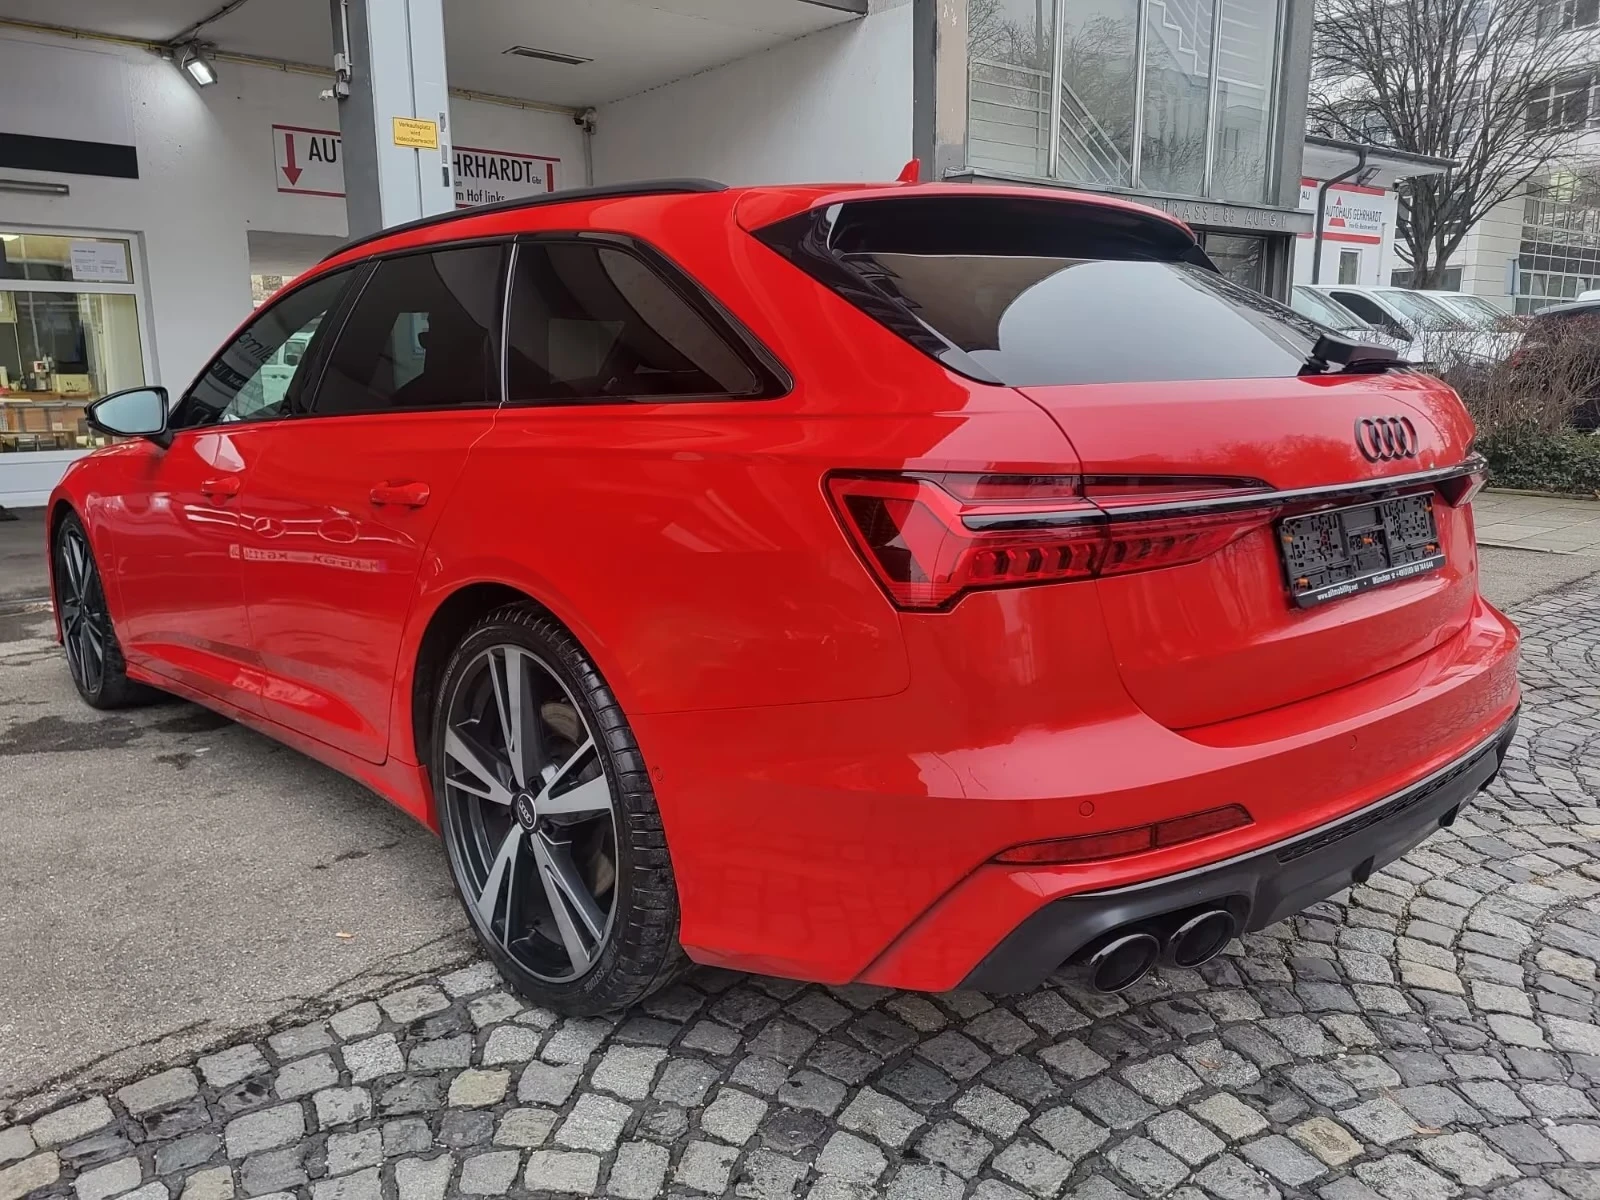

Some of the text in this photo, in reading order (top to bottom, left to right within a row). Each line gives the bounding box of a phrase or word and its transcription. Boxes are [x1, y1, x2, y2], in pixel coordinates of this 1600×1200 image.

[309, 136, 341, 163] AU
[466, 189, 483, 203] Hof
[1325, 205, 1352, 220] AUTOHAUS
